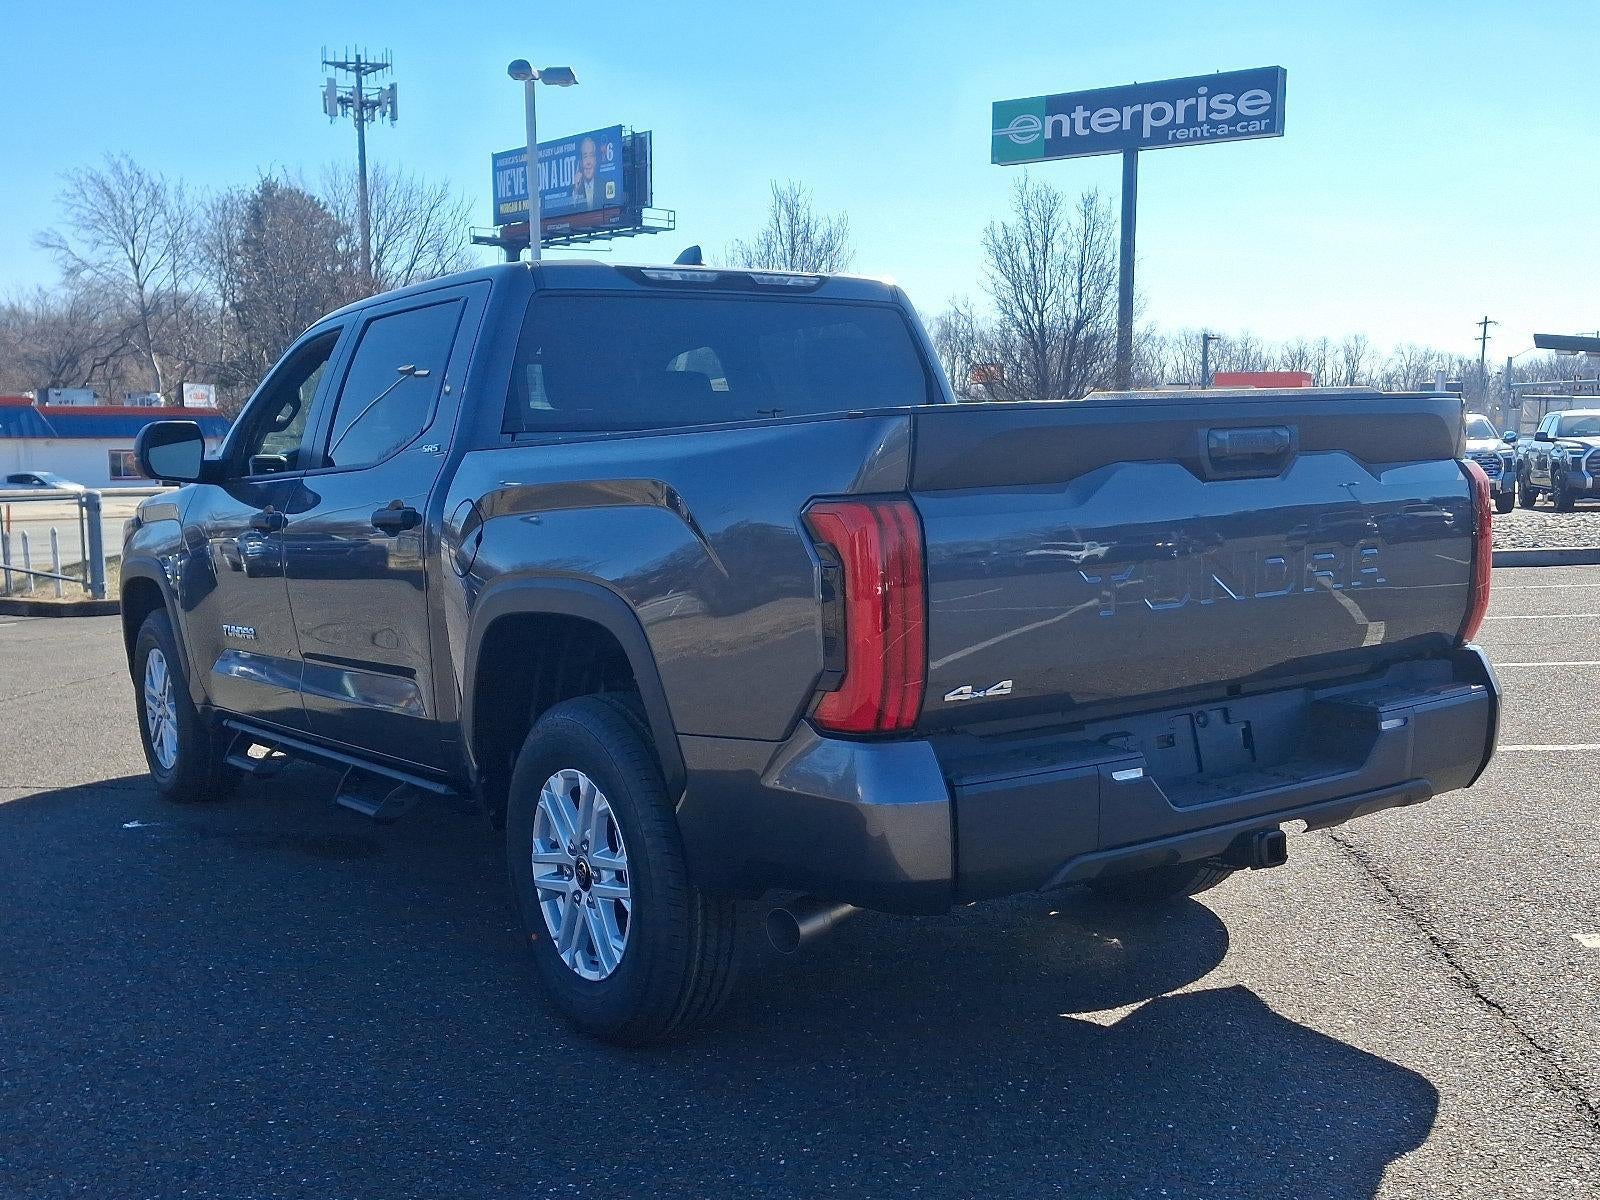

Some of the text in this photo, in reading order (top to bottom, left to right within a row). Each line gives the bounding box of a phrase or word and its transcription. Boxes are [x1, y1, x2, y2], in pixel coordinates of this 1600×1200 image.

[1004, 86, 1272, 145] enterprise
[1167, 117, 1270, 141] rent-a-car
[496, 166, 525, 198] WE'VE
[550, 159, 558, 189] A
[559, 155, 577, 187] LOT
[1077, 541, 1388, 617] TUNDRA
